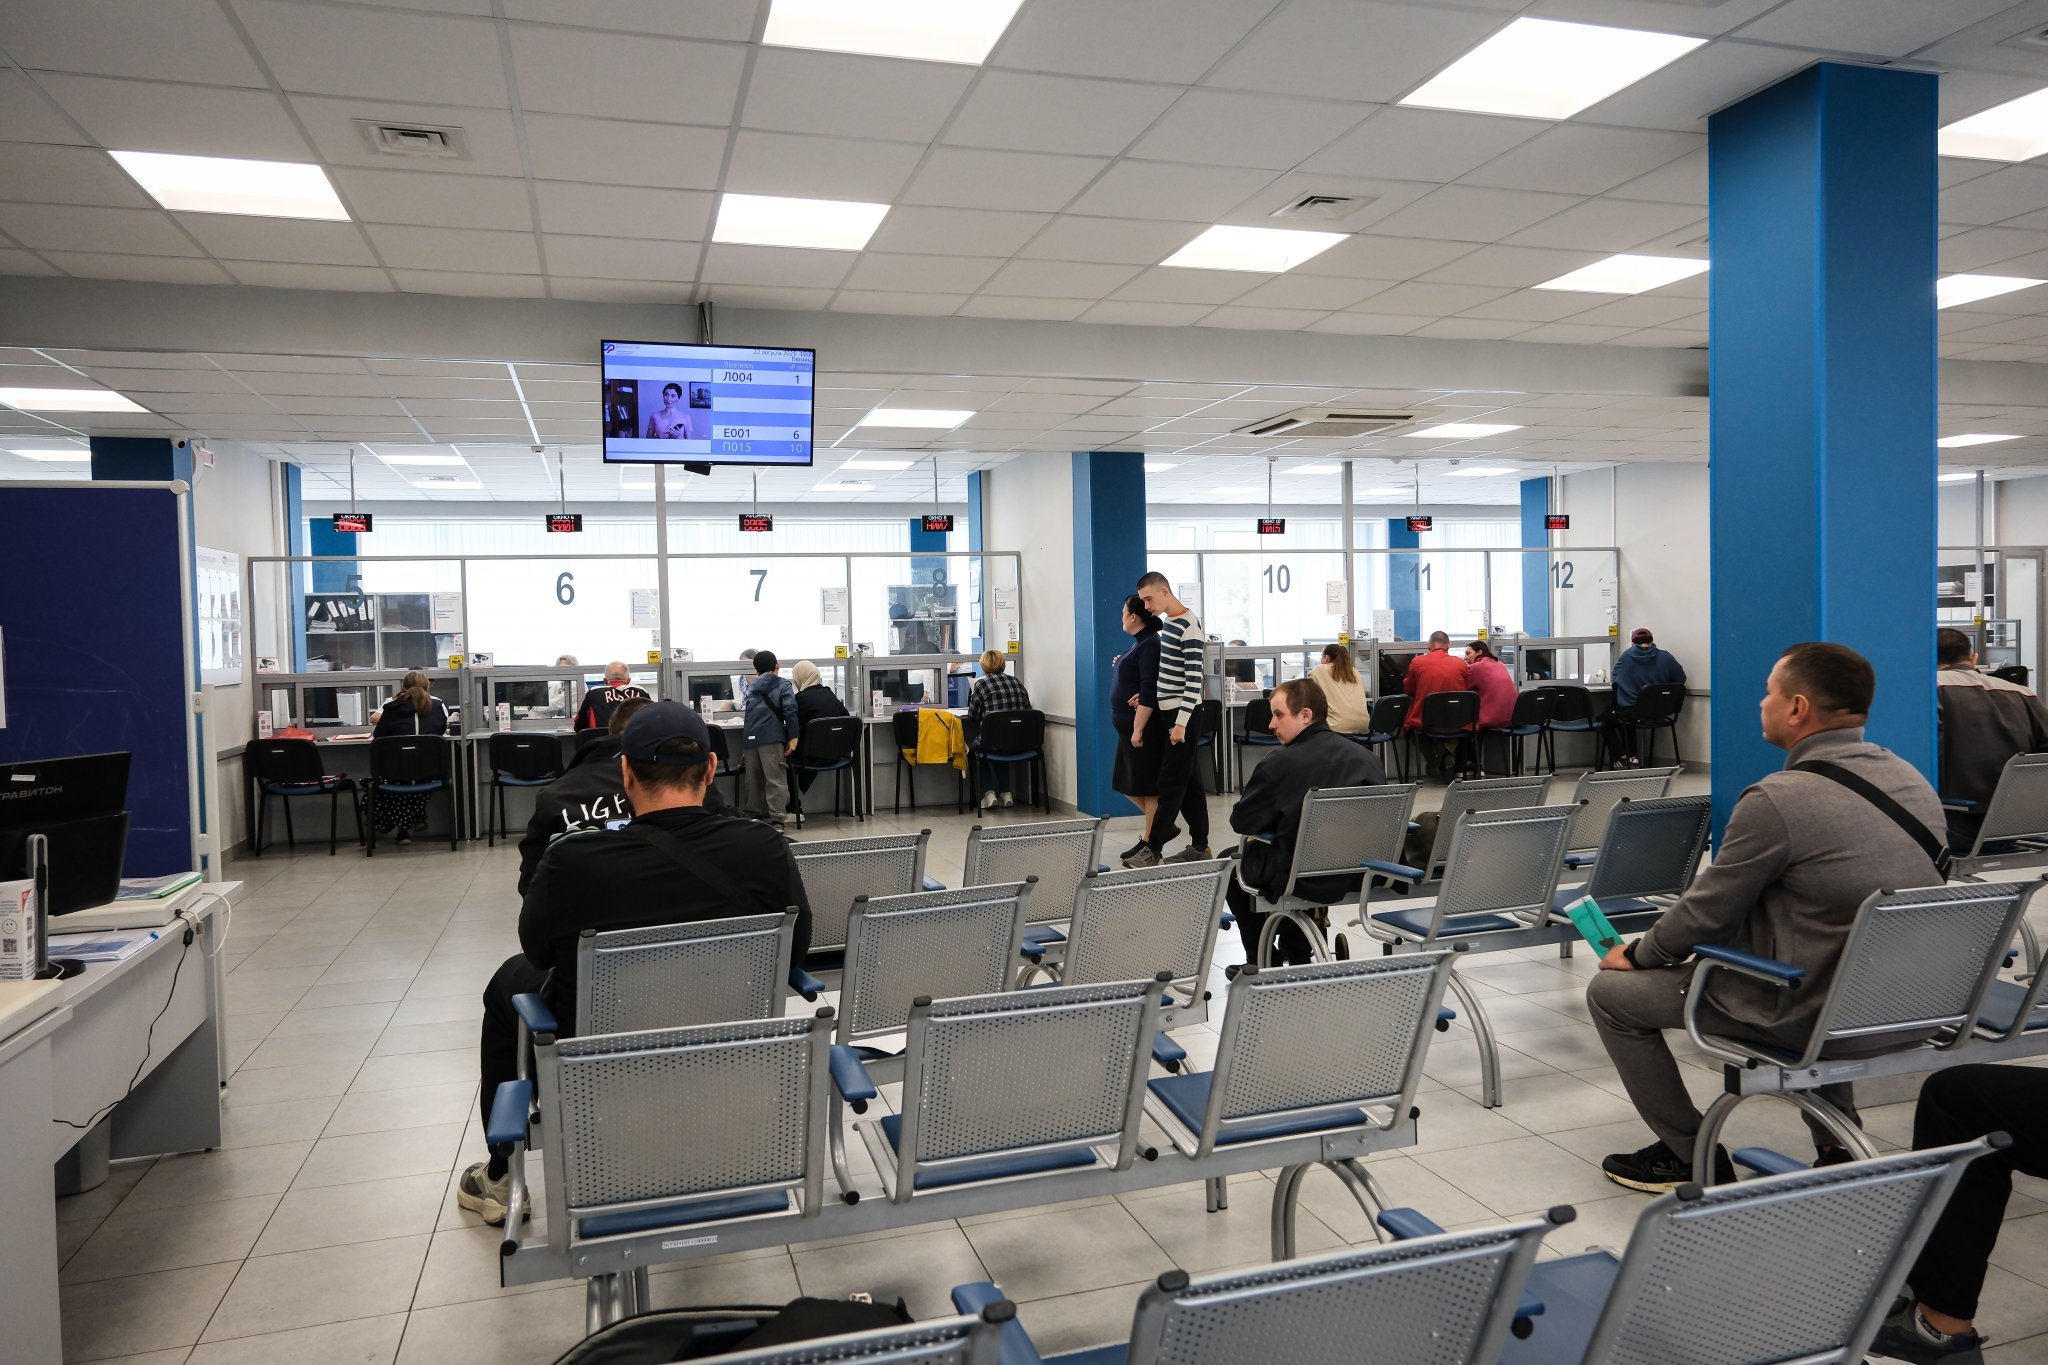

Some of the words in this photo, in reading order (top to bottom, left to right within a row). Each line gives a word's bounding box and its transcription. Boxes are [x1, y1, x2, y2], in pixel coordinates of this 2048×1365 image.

[723, 371, 753, 383] Л004
[795, 374, 800, 385] 1
[722, 441, 752, 453] П015
[790, 443, 803, 454] 10
[723, 428, 751, 439] Е001
[793, 430, 800, 440] 6
[556, 571, 575, 606] 6
[749, 569, 768, 602] 7
[932, 567, 948, 599] 8
[1263, 564, 1291, 594] 10
[1409, 562, 1431, 591] 11
[1550, 560, 1574, 589] 12
[345, 574, 364, 609] 5
[0, 785, 63, 801] РАВИТОН
[561, 793, 632, 828] LIGH
